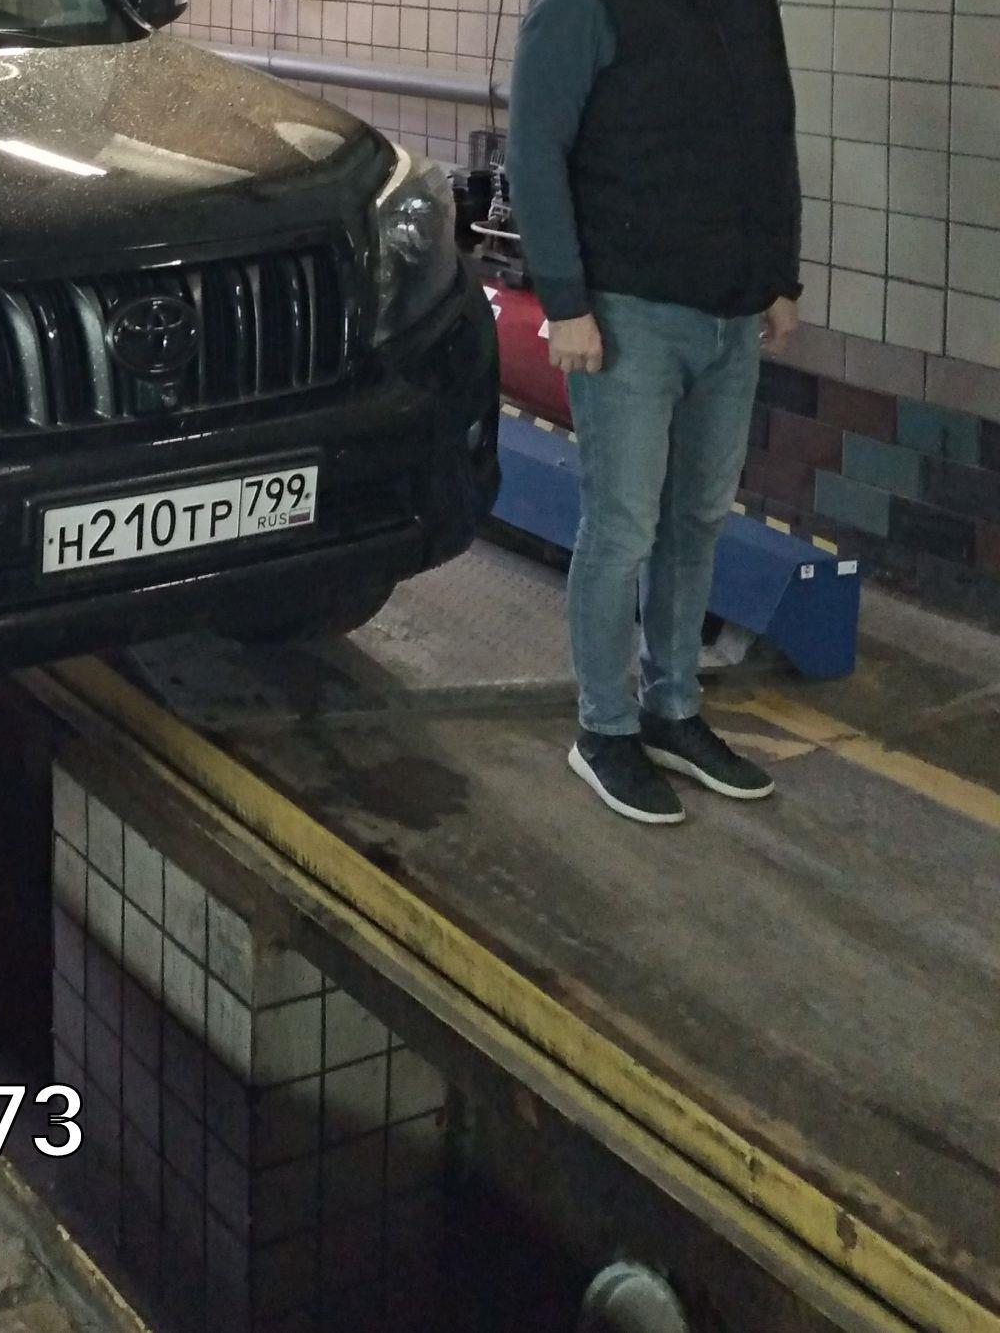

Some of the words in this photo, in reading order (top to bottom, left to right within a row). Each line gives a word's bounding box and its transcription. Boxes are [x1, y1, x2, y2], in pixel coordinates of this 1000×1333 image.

[57, 499, 232, 565] Н210ТР
[245, 473, 306, 517] 799
[257, 512, 288, 530] RUS
